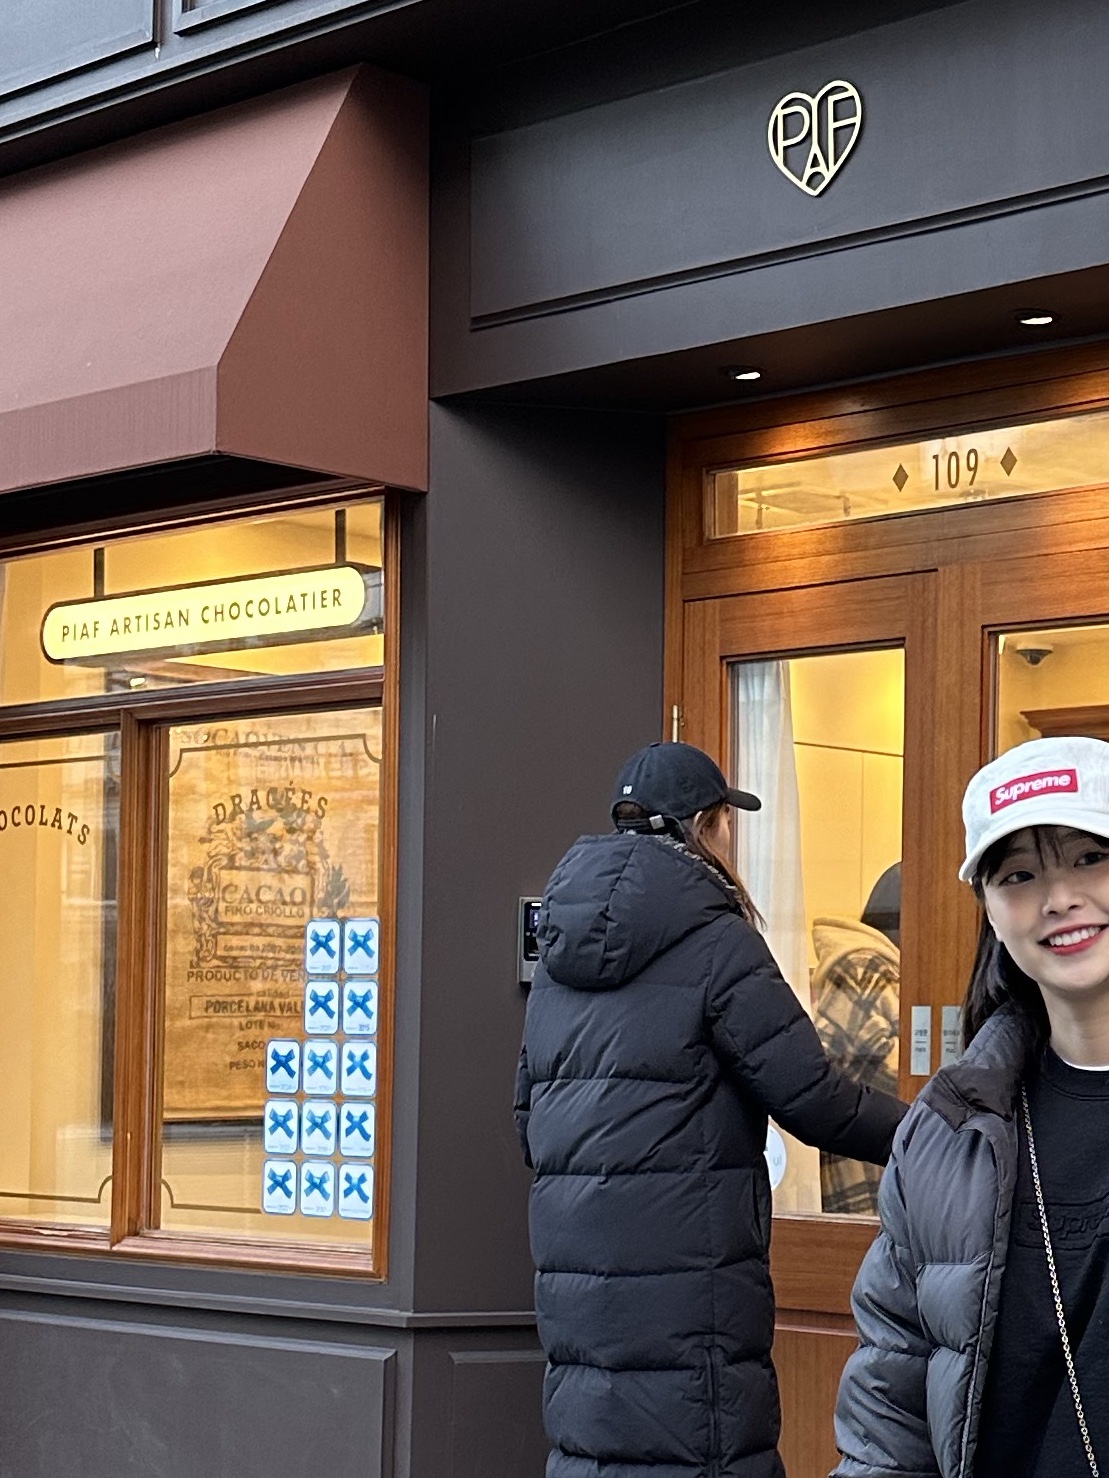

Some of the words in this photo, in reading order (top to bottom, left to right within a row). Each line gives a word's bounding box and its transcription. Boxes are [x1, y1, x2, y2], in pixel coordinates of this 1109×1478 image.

[932, 448, 979, 491] 109
[61, 620, 101, 643] PIAF
[110, 608, 191, 636] ARTISAN
[201, 588, 343, 624] CHOCOLATIER
[995, 774, 1072, 806] Supreme
[221, 883, 308, 906] CACAO
[256, 905, 305, 919] CRIOLLO
[187, 969, 258, 983] PRODUCTO
